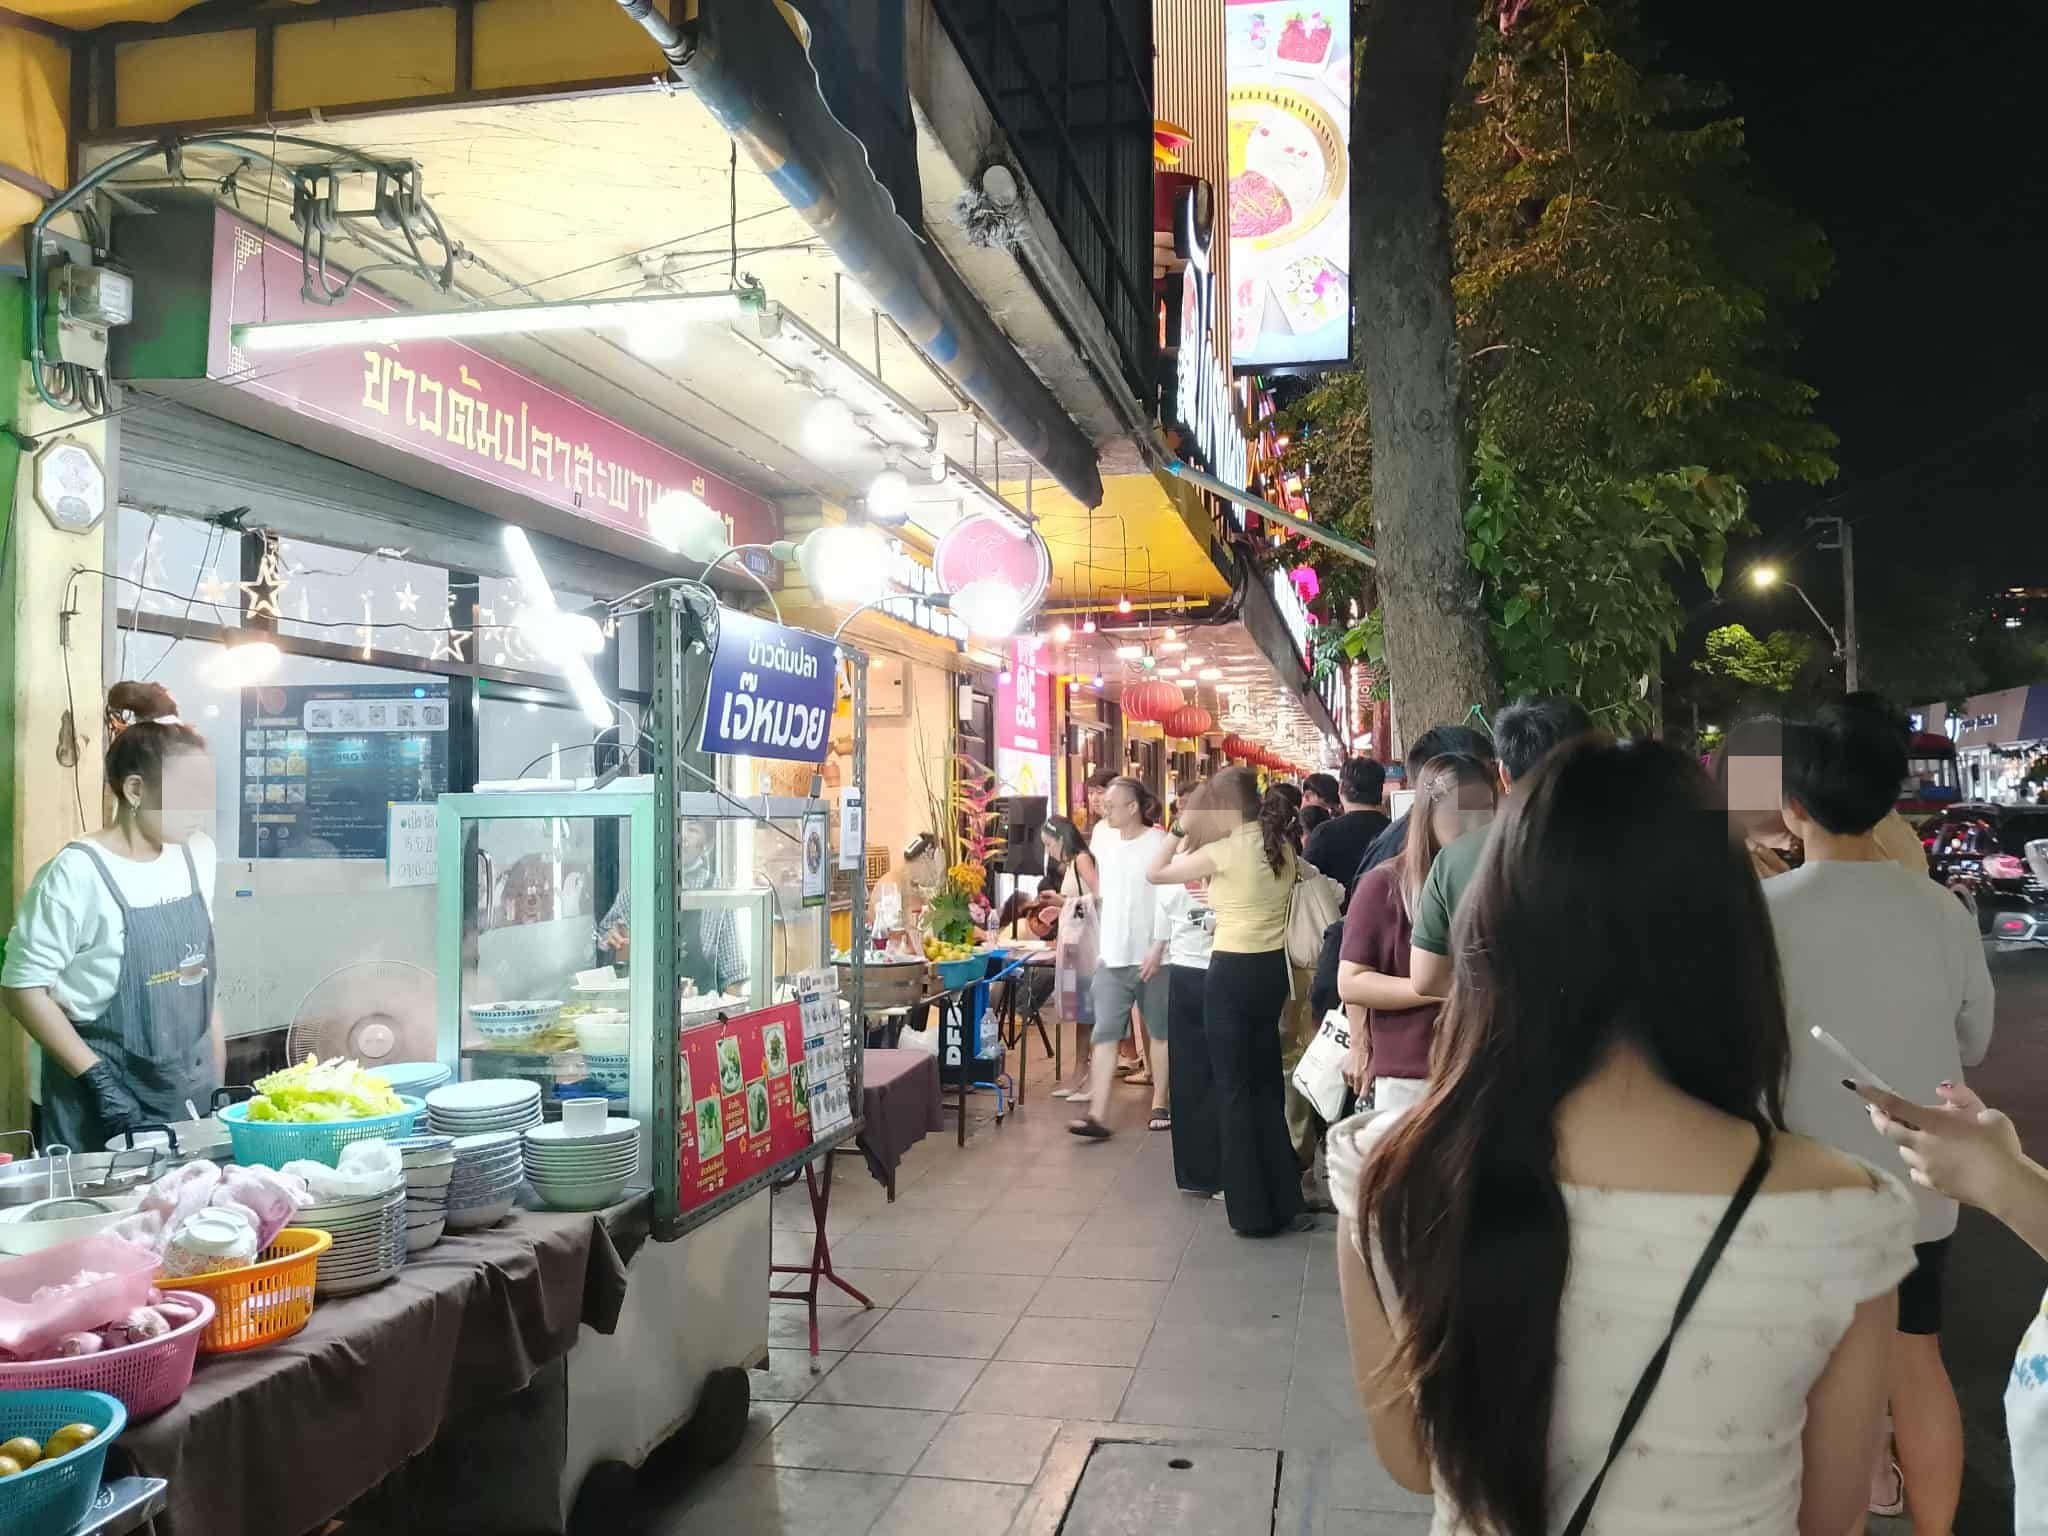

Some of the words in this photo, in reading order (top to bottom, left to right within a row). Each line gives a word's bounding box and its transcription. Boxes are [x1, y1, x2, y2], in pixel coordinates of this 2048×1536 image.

[748, 635, 818, 679] ข้าวต้มปลา
[719, 671, 826, 750] เจ๊หมวย
